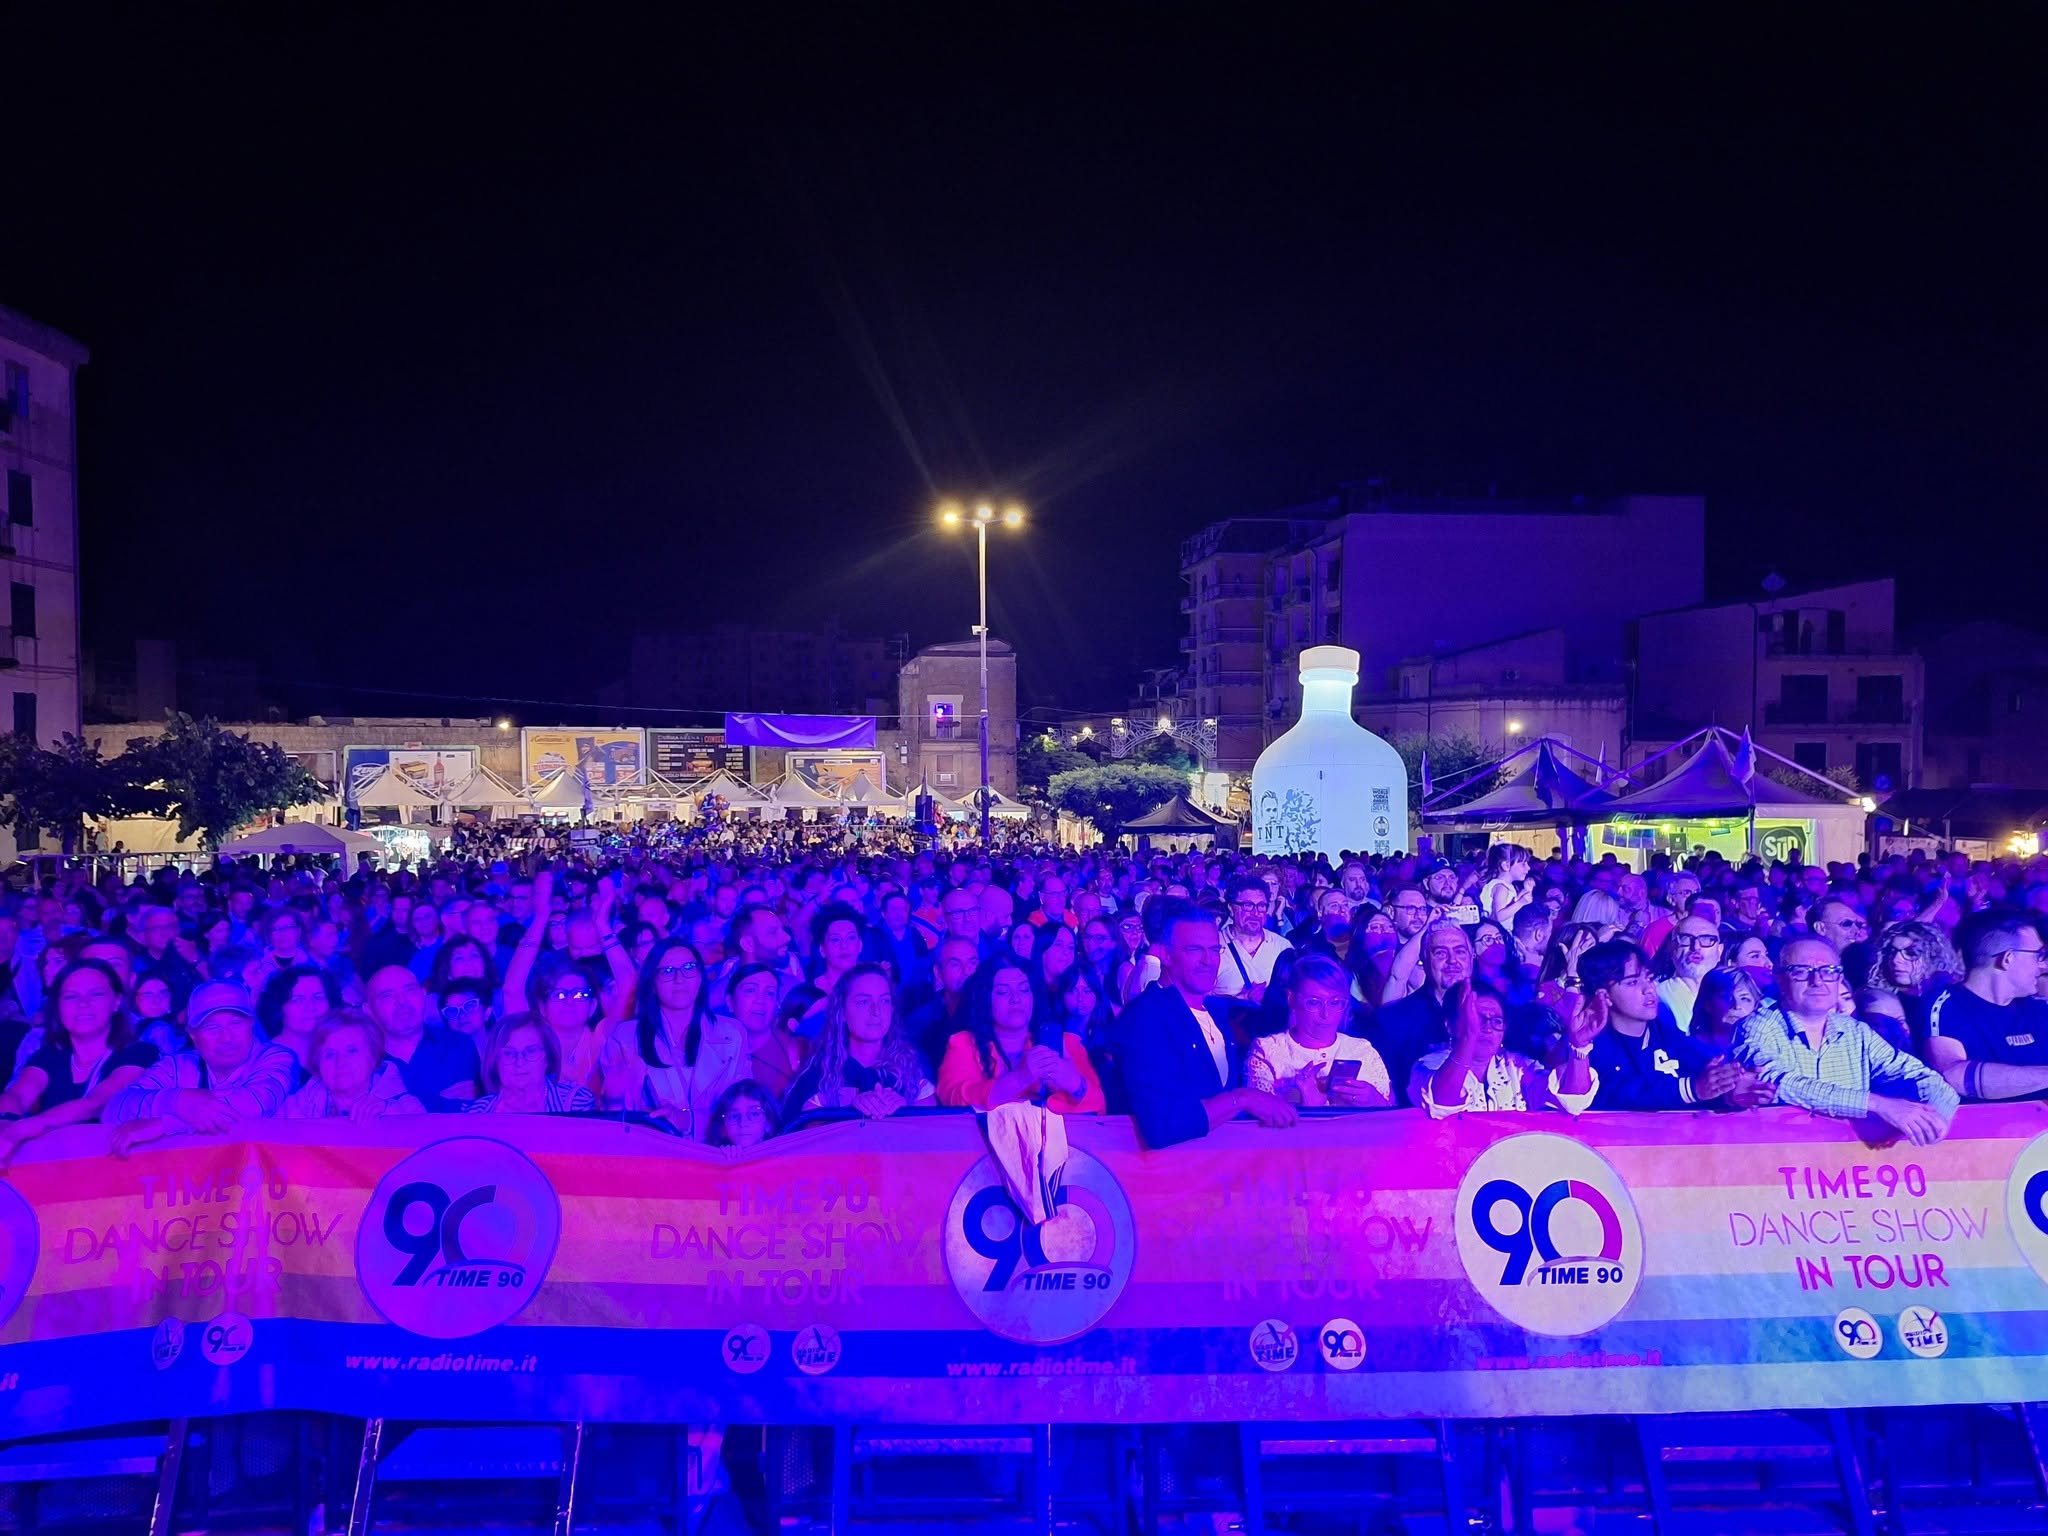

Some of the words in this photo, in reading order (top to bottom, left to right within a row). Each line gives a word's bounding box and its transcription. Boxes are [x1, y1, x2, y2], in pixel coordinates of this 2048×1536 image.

[137, 1167, 288, 1209] TIME90
[714, 1177, 869, 1216] TIME90
[1778, 1164, 1927, 1200] TIME90
[64, 1215, 209, 1264] DANCE
[218, 1211, 344, 1247] SHOW
[383, 1182, 537, 1287] 90
[650, 1223, 787, 1260] DANCE
[801, 1221, 923, 1260] SHOW
[963, 1185, 1116, 1292] 90
[1472, 1180, 1623, 1286] 90
[1729, 1210, 1861, 1246] DANCE
[1871, 1207, 1988, 1243] SHOW
[179, 1256, 283, 1298] TOUR
[436, 1269, 492, 1288] TIME
[497, 1271, 524, 1288] 90
[706, 1270, 744, 1305] IN
[758, 1269, 865, 1306] TOUR
[1023, 1273, 1077, 1290] TIME
[1083, 1272, 1111, 1290] 90
[1538, 1267, 1589, 1285] TIME
[1597, 1267, 1623, 1284] 90
[1795, 1256, 1835, 1290] IN
[1843, 1253, 1950, 1290] TOUR
[1323, 1330, 1362, 1358] 90
[1839, 1320, 1876, 1346] 90
[1906, 1333, 1945, 1347] TIME
[345, 1352, 538, 1373] www.radiotime.it
[798, 1352, 836, 1365] TIME
[947, 1358, 1137, 1377] www.radiotime.it
[1257, 1347, 1294, 1361] TIME
